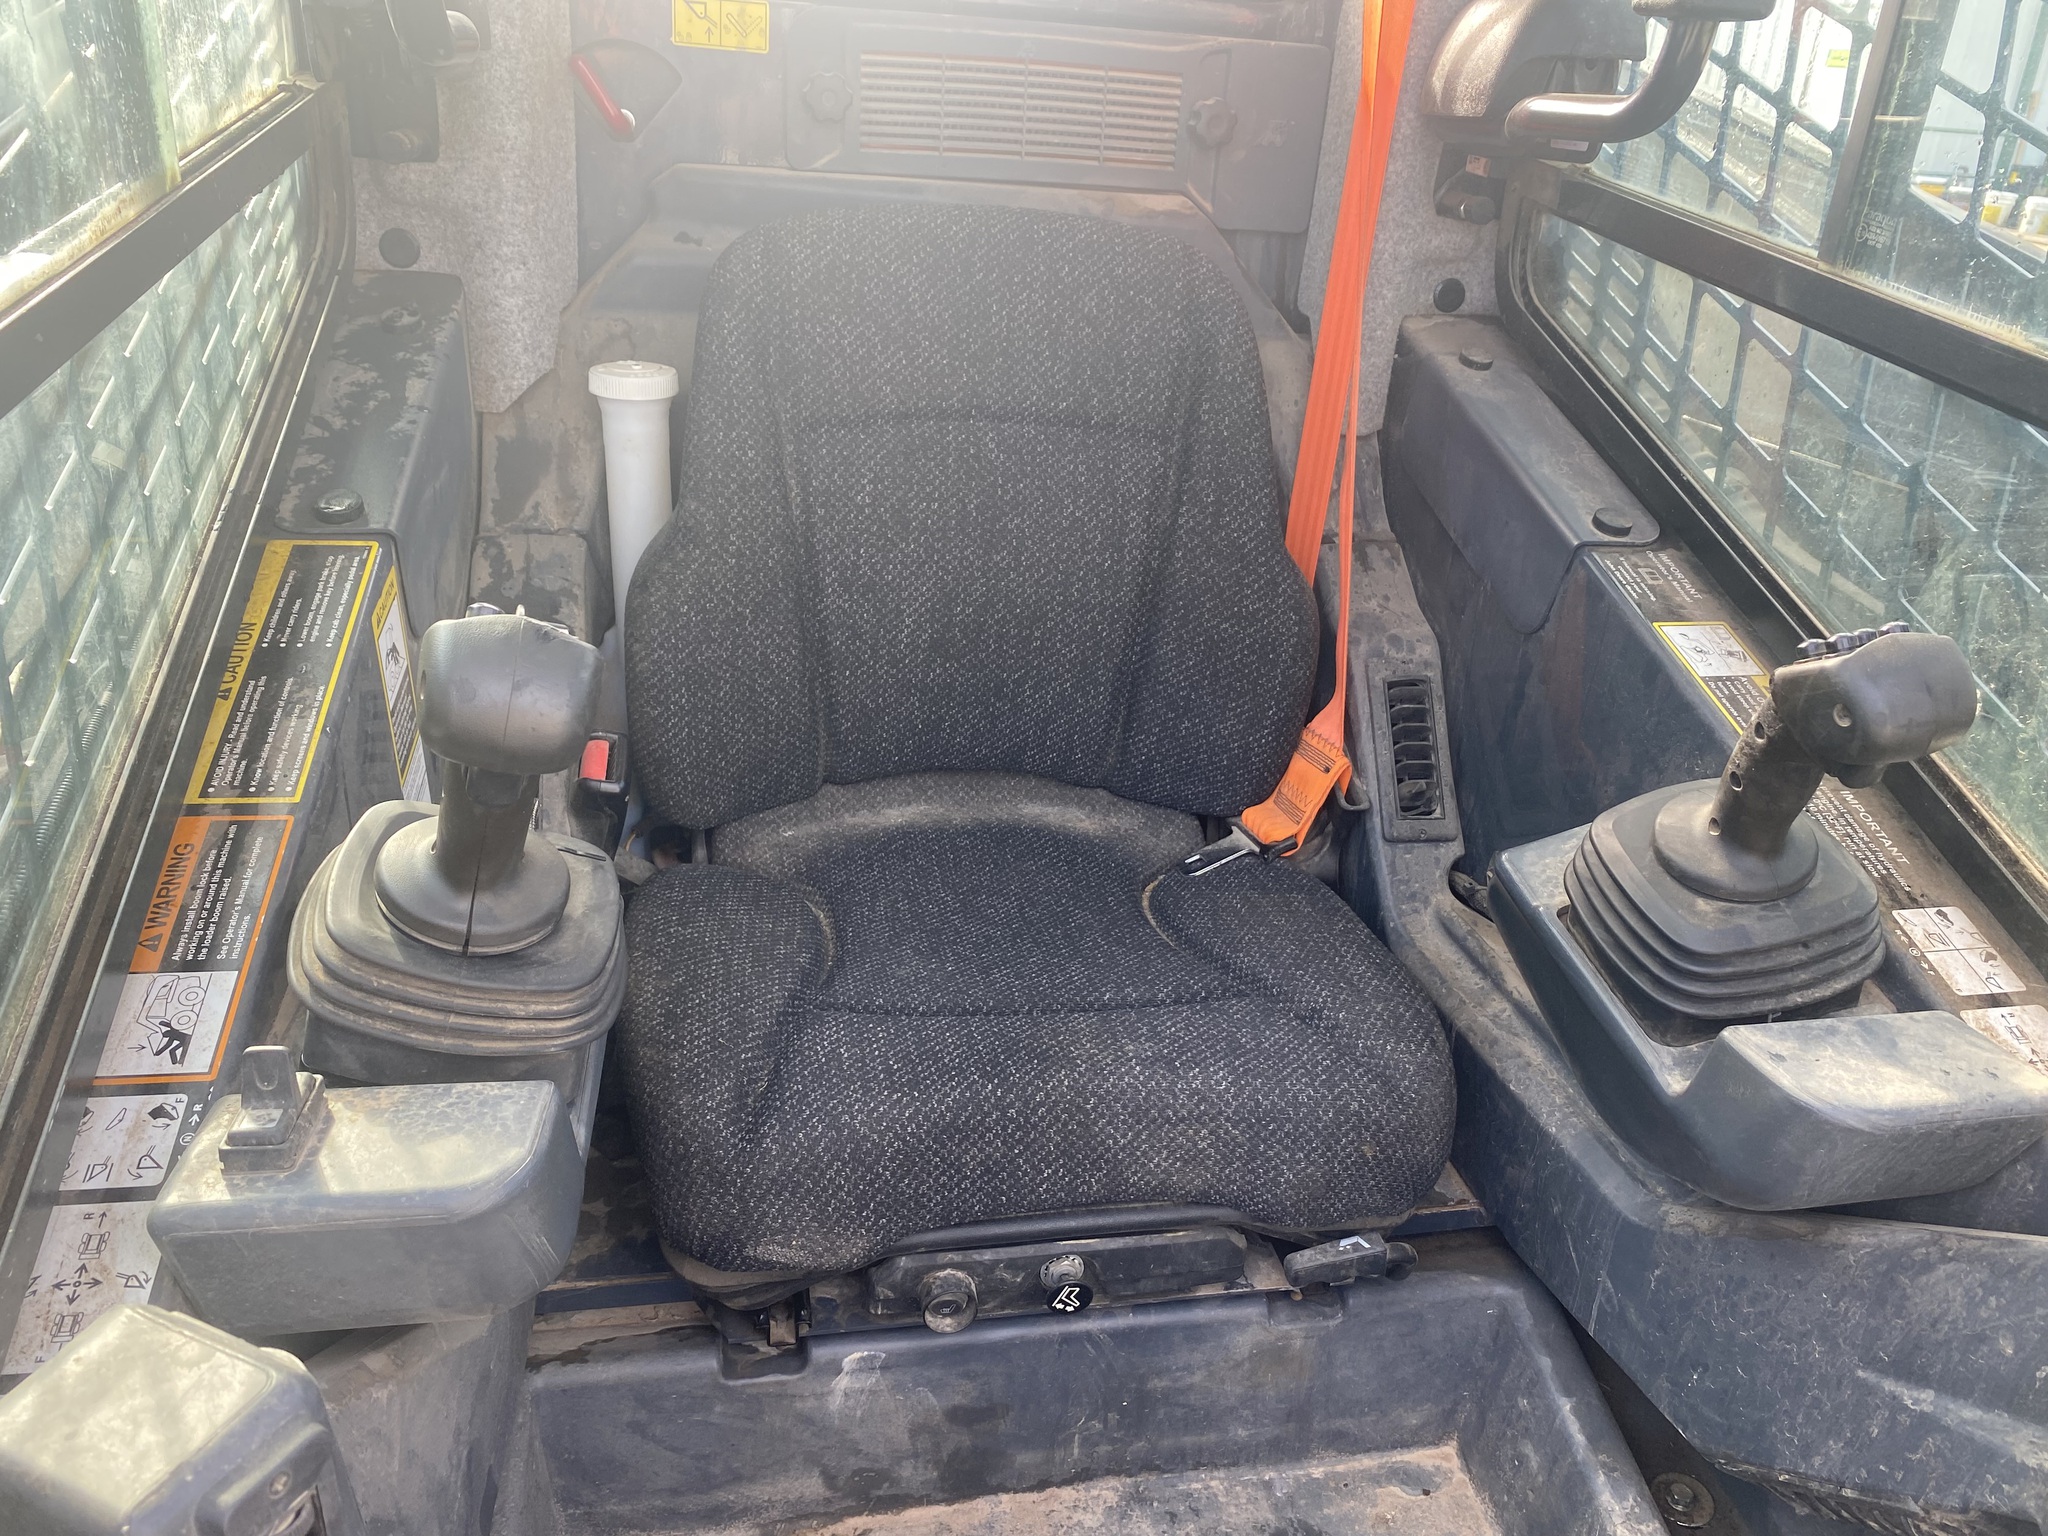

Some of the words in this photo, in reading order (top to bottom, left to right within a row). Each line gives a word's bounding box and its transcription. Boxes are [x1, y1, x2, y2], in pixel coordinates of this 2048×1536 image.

[327, 572, 337, 587] before
[1618, 566, 1634, 582] contact
[1646, 551, 1673, 580] Operator's
[1671, 581, 1693, 602] Manual
[1658, 554, 1702, 599] IMPORTANT
[324, 588, 334, 596] key
[326, 629, 338, 642] Keep
[332, 619, 340, 628] cab
[340, 580, 354, 603] especially
[348, 567, 356, 580] pedal
[352, 556, 360, 567] area.
[292, 598, 302, 613] riders.
[298, 627, 309, 642] Lower
[311, 593, 322, 610] engage
[317, 582, 325, 592] park
[319, 597, 329, 614] remove
[263, 629, 275, 642] Keep
[269, 608, 281, 628] children
[277, 598, 285, 607] and
[288, 614, 298, 626] carry
[280, 627, 292, 642] Never
[310, 625, 320, 642] engine
[221, 623, 257, 684] CAUTION
[281, 677, 293, 700] controls.
[315, 686, 325, 700] place.
[1725, 681, 1739, 694] Avoid
[1737, 695, 1749, 708] steep
[1734, 681, 1746, 693] Carry
[1739, 677, 1759, 695] Avoid
[1722, 698, 1738, 716] operate
[269, 708, 283, 731] function
[305, 708, 318, 732] windows
[211, 766, 224, 786] AVOID
[218, 743, 232, 765] INJURY
[228, 724, 240, 738] Read
[235, 712, 244, 722] and
[240, 680, 255, 711] understand
[221, 754, 239, 786] Operator's
[233, 733, 246, 753] Manual
[240, 714, 253, 731] before
[249, 687, 265, 712] operating
[258, 676, 267, 686] this
[267, 732, 275, 742] and
[281, 728, 294, 749] devices
[302, 733, 310, 743] and
[256, 744, 271, 767] location
[276, 751, 288, 768] safety
[294, 745, 306, 768] screens
[233, 759, 248, 785] machine.
[250, 768, 262, 785] Know
[269, 770, 282, 785] Keep
[287, 770, 299, 785] Keep
[227, 825, 237, 838] with
[1840, 791, 1909, 864] IMPORTANT
[1819, 786, 1847, 812] prevent
[1844, 814, 1870, 841] damage
[1875, 853, 1911, 891] hydraulics
[202, 850, 217, 871] before
[218, 840, 232, 868] machine
[248, 837, 263, 867] complete
[1845, 826, 1887, 874] temperatures
[211, 869, 222, 882] this
[243, 868, 253, 878] for
[1862, 860, 1881, 877] slow
[144, 843, 194, 929] WARNING
[197, 872, 209, 887] lock
[219, 877, 232, 900] raised.
[189, 889, 204, 909] boom
[204, 884, 217, 908] around
[234, 880, 249, 904] Manual
[181, 911, 196, 932] install
[201, 910, 208, 918] or
[209, 901, 224, 922] boom
[197, 920, 205, 929] on
[201, 923, 216, 946] loader
[222, 906, 241, 943] Operator's
[186, 931, 204, 960] working
[229, 914, 251, 959] instructions.
[171, 934, 188, 961] Always
[197, 948, 208, 960] the
[217, 945, 229, 959] See
[193, 1103, 203, 1111] R
[83, 1212, 95, 1220] R
